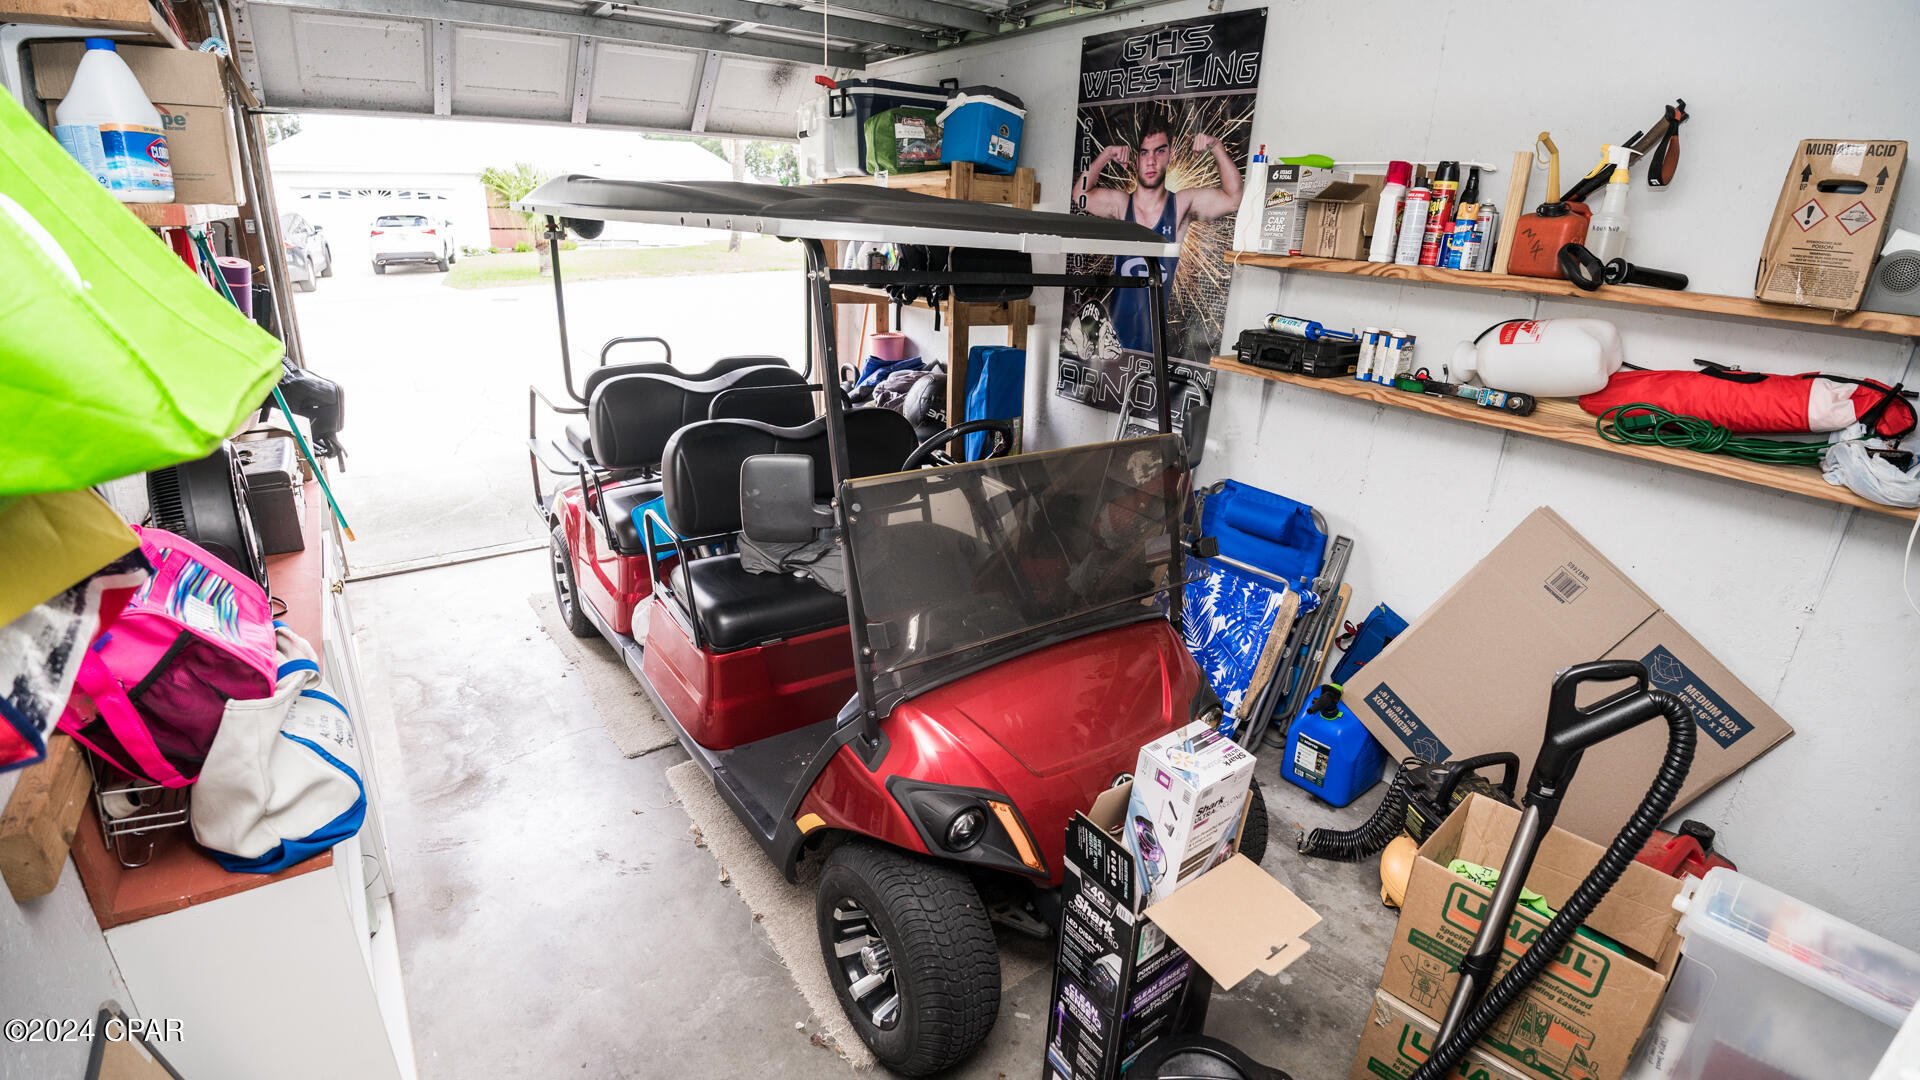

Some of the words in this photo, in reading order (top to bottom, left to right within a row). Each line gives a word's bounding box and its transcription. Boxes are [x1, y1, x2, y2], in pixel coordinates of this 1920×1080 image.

[1122, 24, 1215, 62] GHS
[1082, 50, 1260, 99] WRESTLING
[1866, 144, 1897, 157] ACID
[1272, 170, 1280, 180] 6
[1874, 186, 1884, 194] UP
[1264, 225, 1286, 233] CARE
[1267, 217, 1285, 225] CAR
[1081, 303, 1100, 321] GHS
[1372, 694, 1388, 710] BOX
[1378, 690, 1391, 700] 16"
[1684, 684, 1722, 718] MEDIUM
[1719, 715, 1742, 735] BOX
[1385, 707, 1413, 737] MEDIUM
[1696, 708, 1712, 721] 16"
[1715, 726, 1732, 740] 16"
[1223, 751, 1247, 767] Shark
[1196, 795, 1225, 817] Shark
[1090, 886, 1106, 904] 40
[1067, 900, 1103, 936] CORDLESS
[1103, 932, 1119, 950] PRO
[1074, 893, 1115, 938] Shark
[1066, 915, 1079, 930] LED
[1078, 927, 1105, 953] DISPLAY
[1439, 925, 1473, 946] Specific
[1457, 892, 1593, 979] UHAUL
[1444, 937, 1468, 953] Make
[1133, 983, 1158, 1005] CLEAN
[1158, 968, 1181, 988] SENSE
[1063, 986, 1092, 1021] SENSE
[1091, 1015, 1102, 1031] IQ
[1068, 983, 1099, 1018] CLEAN
[1553, 1017, 1581, 1038] U-HAUL
